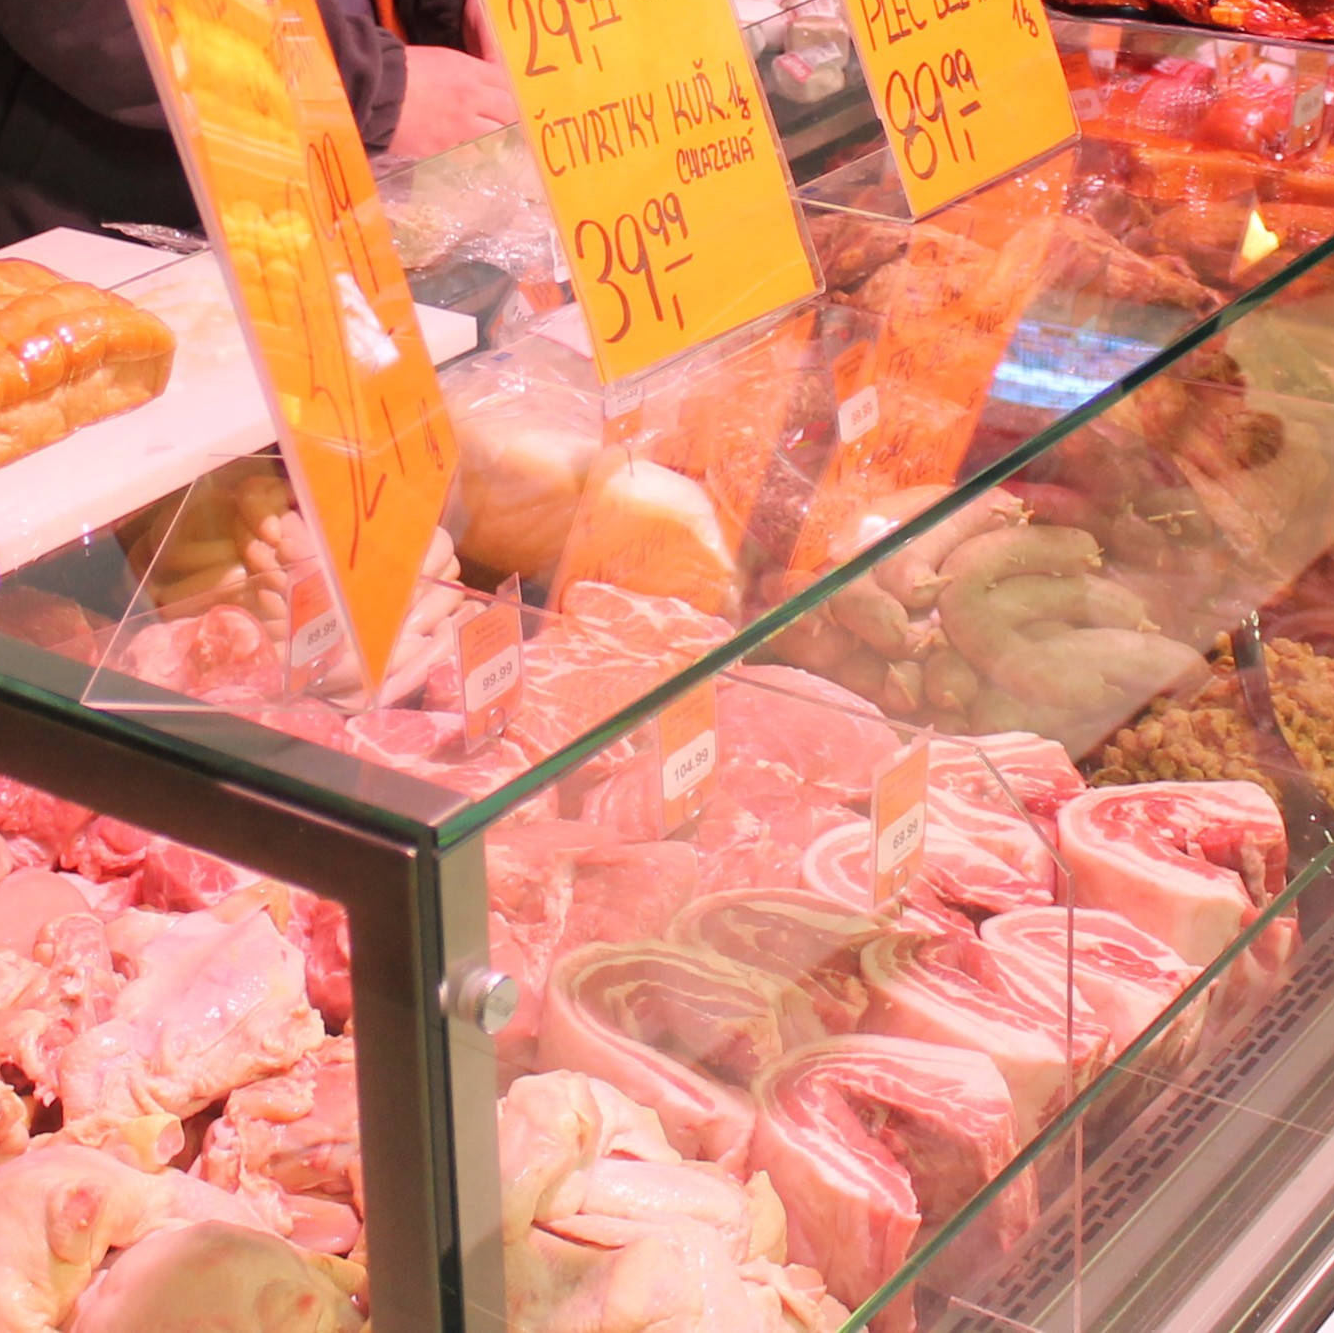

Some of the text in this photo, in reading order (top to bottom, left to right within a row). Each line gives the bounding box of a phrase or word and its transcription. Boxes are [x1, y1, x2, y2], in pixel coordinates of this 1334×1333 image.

[534, 91, 660, 177] ČTVRTKY
[482, 661, 513, 692] 99.99
[674, 748, 709, 782] 104.99
[892, 819, 919, 850] 69.99
